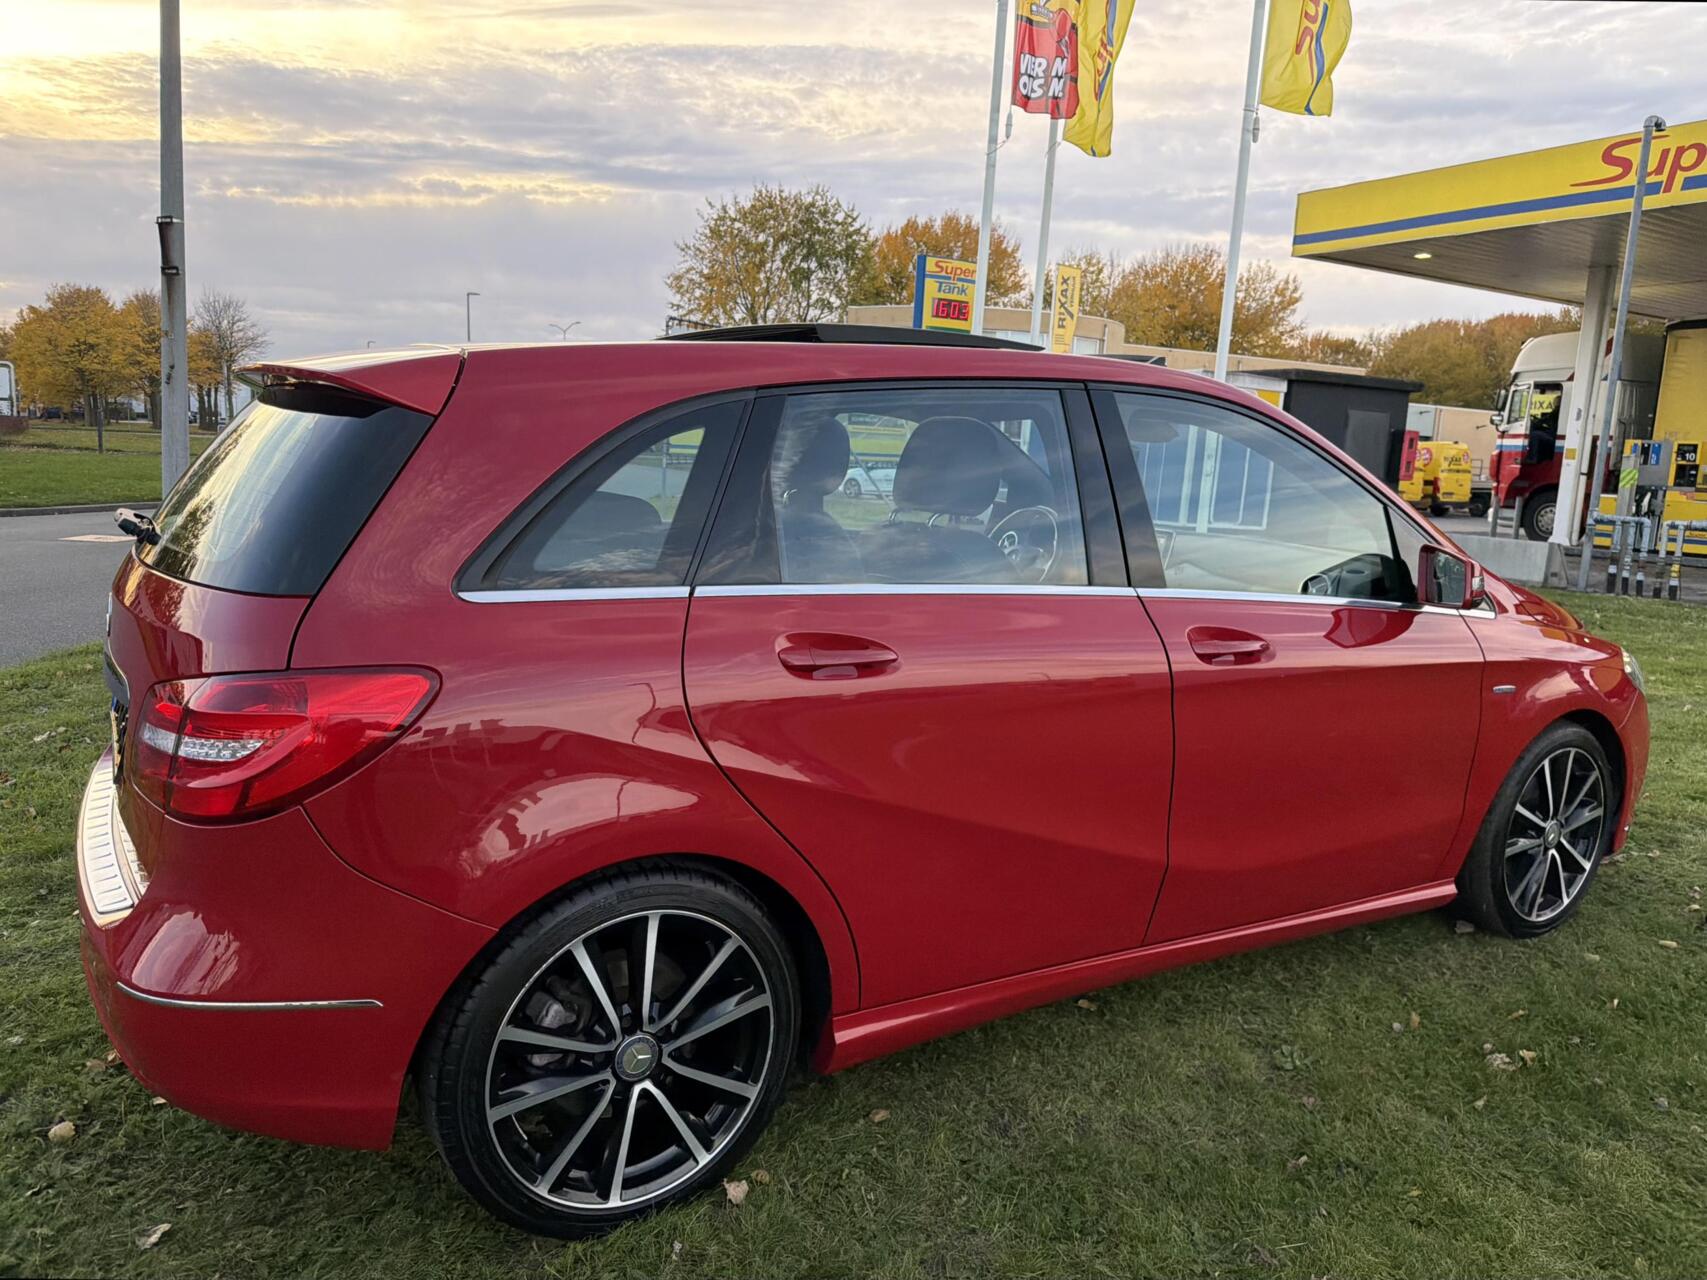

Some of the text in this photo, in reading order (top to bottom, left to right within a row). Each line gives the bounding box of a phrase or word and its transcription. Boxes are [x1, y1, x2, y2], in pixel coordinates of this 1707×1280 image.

[926, 260, 976, 281] Super
[934, 280, 968, 296] Tank
[1685, 452, 1696, 461] 10
